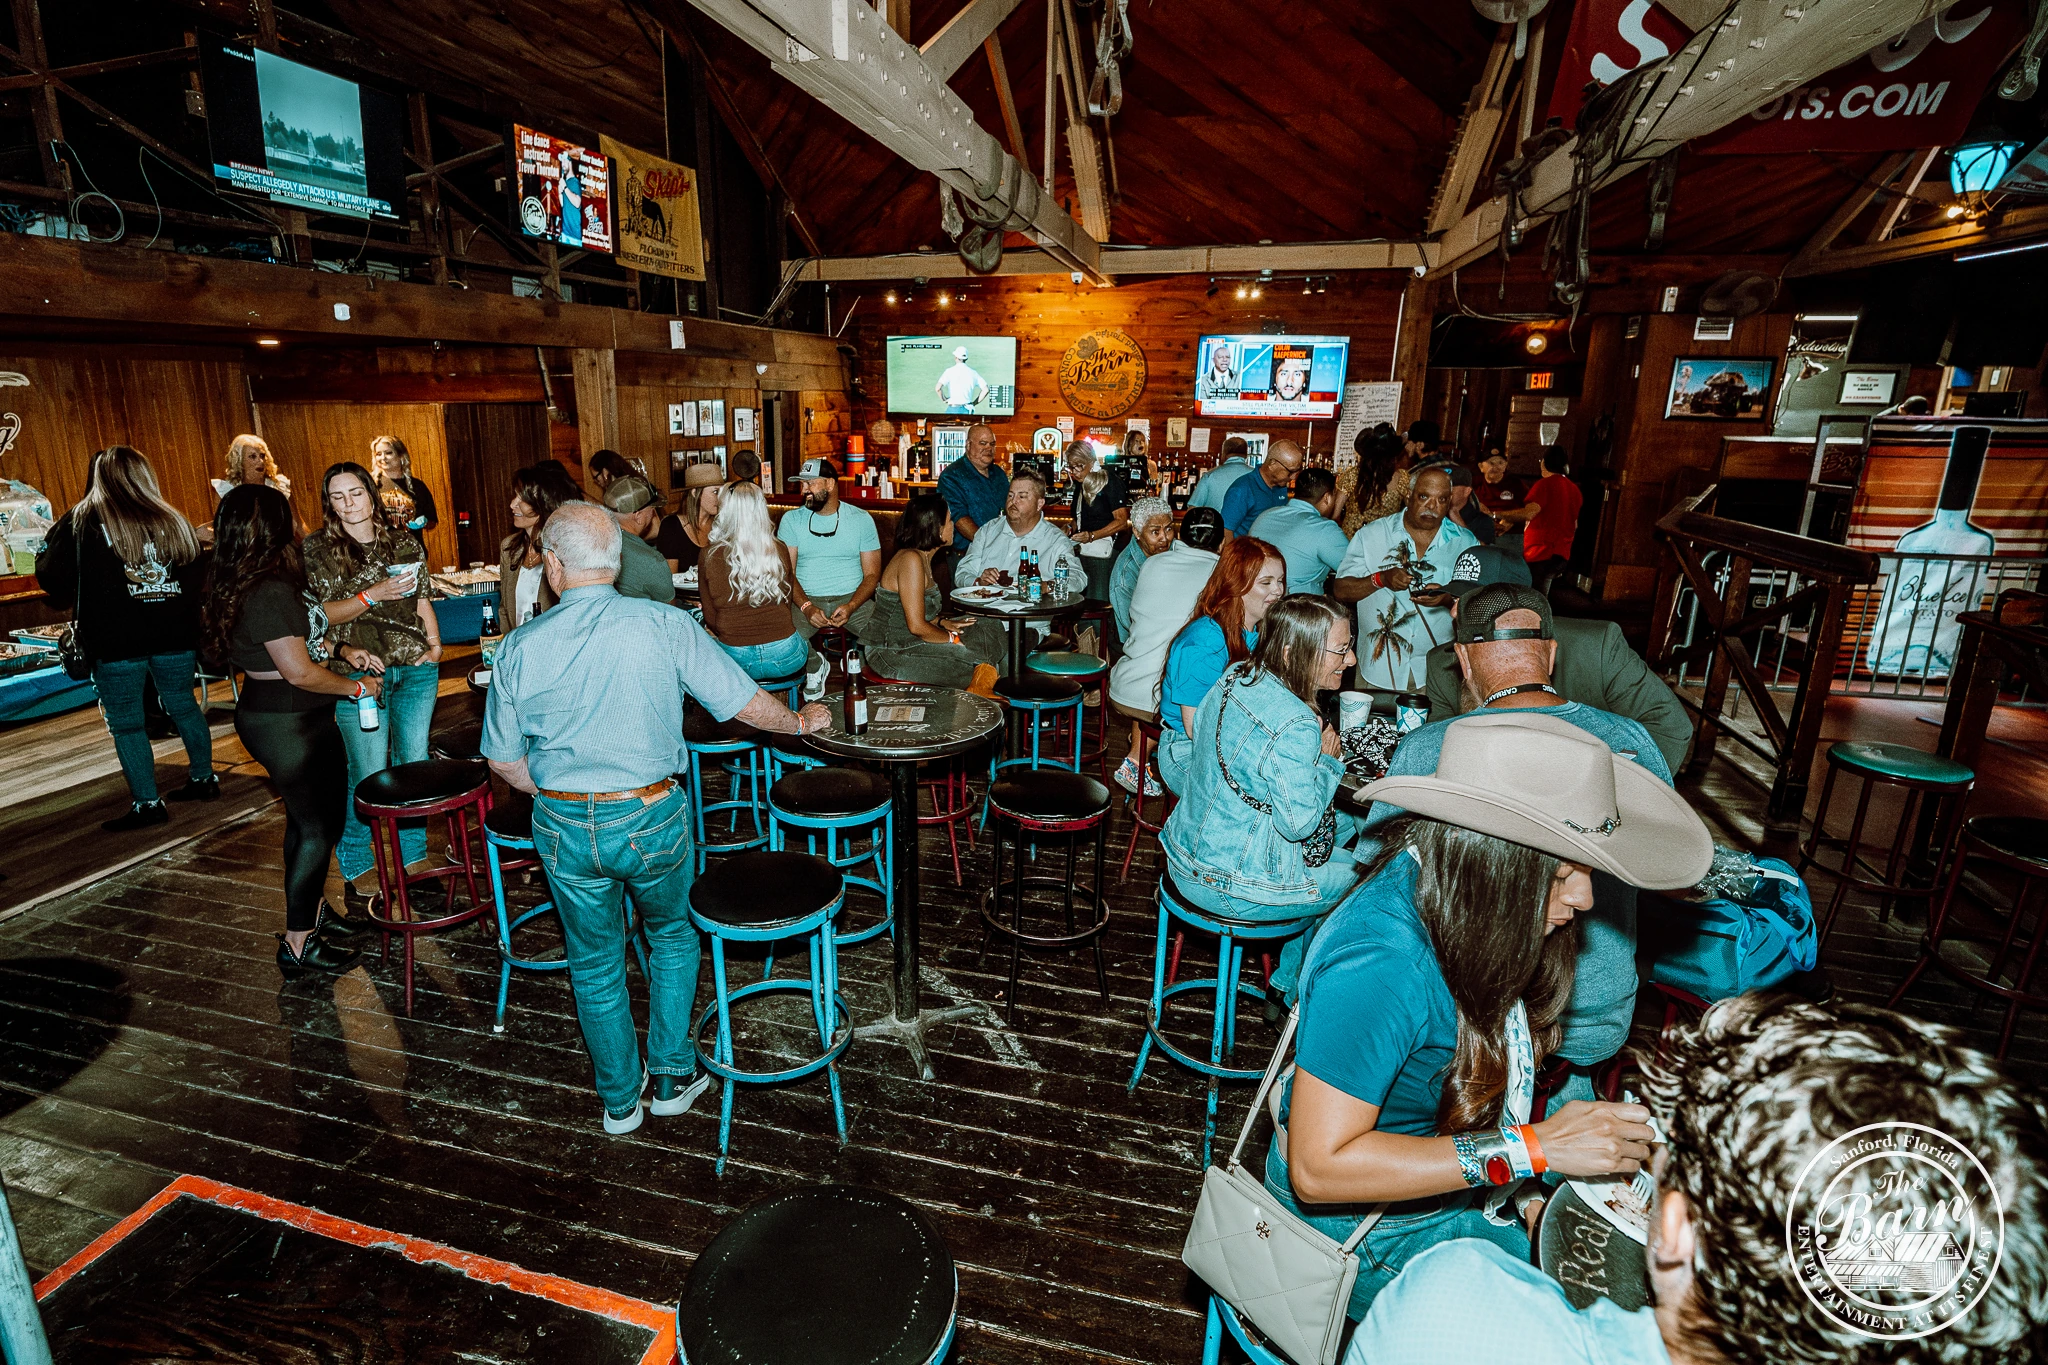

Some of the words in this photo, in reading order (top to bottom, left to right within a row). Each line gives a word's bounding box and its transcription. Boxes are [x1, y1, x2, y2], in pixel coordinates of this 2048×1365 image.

[1749, 81, 1950, 121] OTS.COM
[521, 131, 533, 145] Line
[533, 133, 550, 148] dance
[523, 146, 551, 162] instructor
[230, 162, 257, 173] BREAKING
[257, 167, 274, 176] NEWS
[518, 159, 536, 174] Trevor
[230, 170, 262, 184] SUSPECT
[262, 176, 297, 191] ALLEGEDLY
[298, 183, 326, 198] ATTACKS
[326, 190, 336, 200] U.S.
[337, 192, 363, 206] MILITARY
[362, 197, 380, 209] PLANE
[231, 180, 244, 189] MAN
[244, 182, 271, 194] ARRESTED
[271, 188, 282, 196] FOR
[282, 190, 309, 201] "EXTENSIVE
[352, 204, 366, 212] FORCE
[620, 251, 654, 266] WESTERN
[654, 258, 695, 274] OUTFITTERS
[1790, 337, 1847, 352] udweise
[1089, 347, 1117, 366] The
[1273, 351, 1307, 359] KAEPERNICK
[1067, 351, 1132, 386] Barn
[1060, 348, 1076, 391] COUNTRY
[1068, 392, 1096, 415] MUSIC
[1125, 370, 1144, 404] FINEST
[1530, 372, 1551, 389] EXIT
[127, 580, 182, 597] CLASSIC
[1899, 575, 1941, 602] Blue
[1941, 576, 1967, 603] Ice
[1488, 686, 1518, 702] CARMAN
[1557, 1205, 1614, 1296] Real
